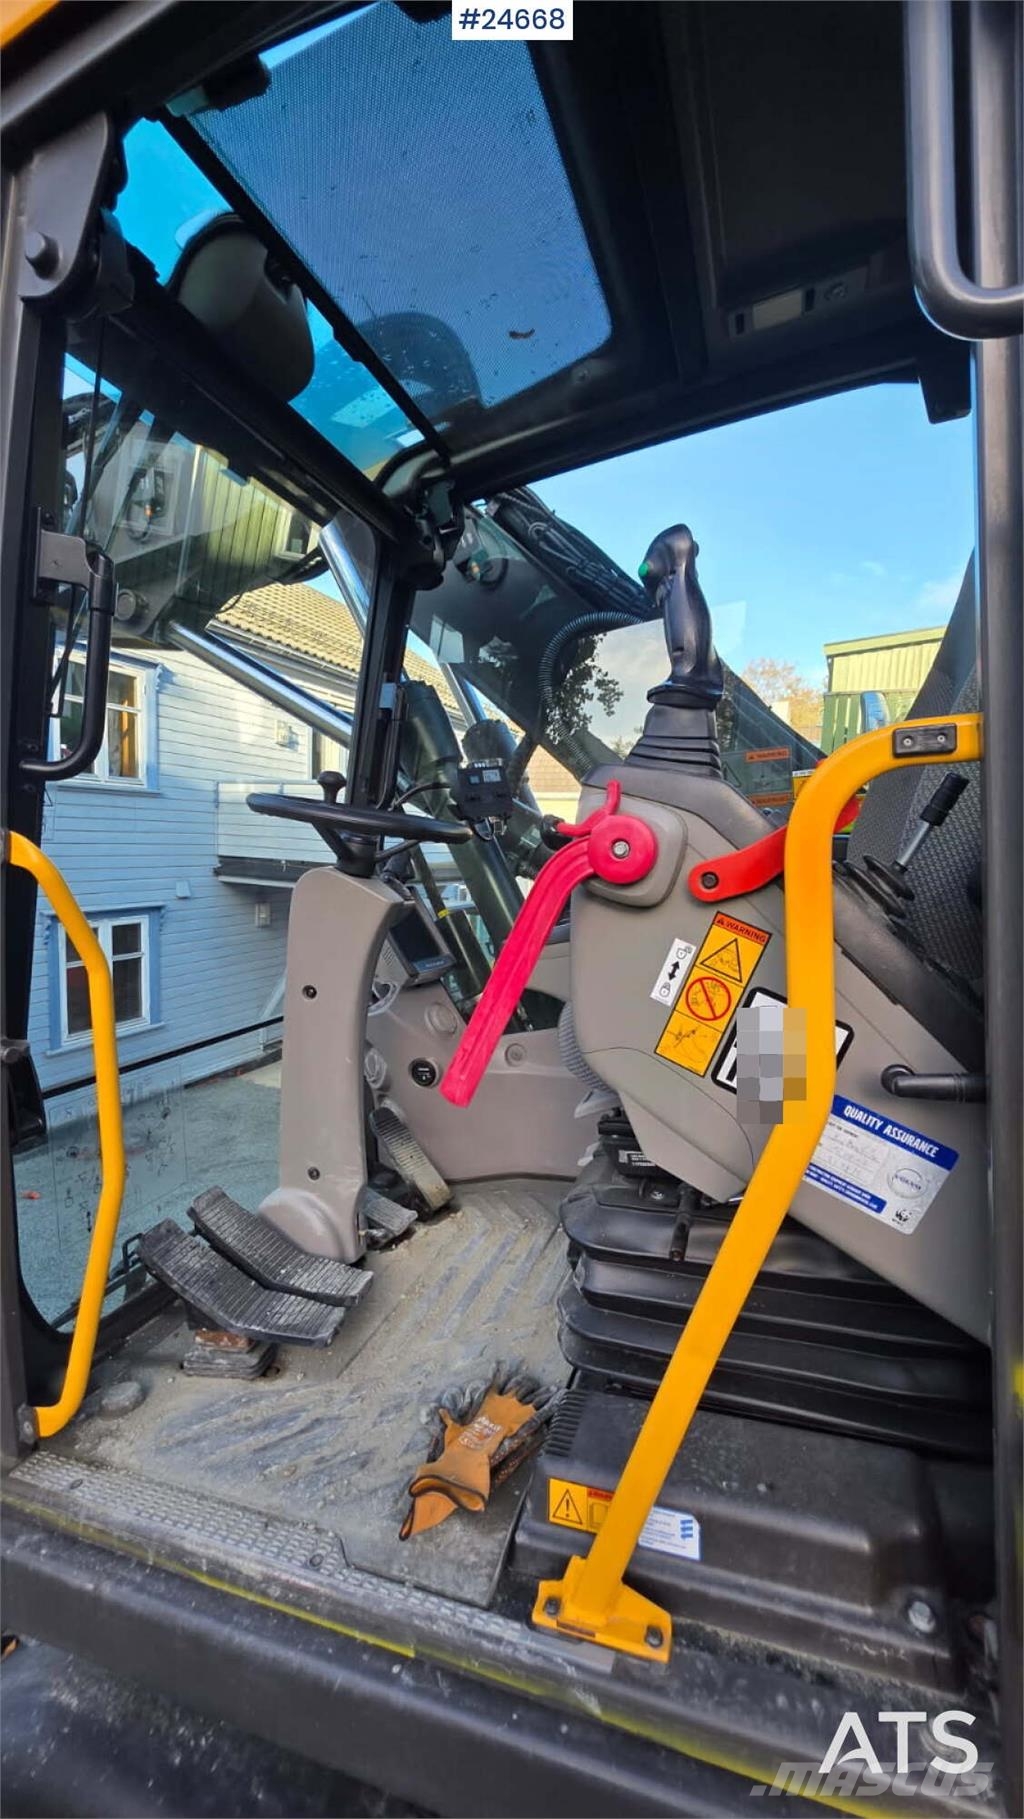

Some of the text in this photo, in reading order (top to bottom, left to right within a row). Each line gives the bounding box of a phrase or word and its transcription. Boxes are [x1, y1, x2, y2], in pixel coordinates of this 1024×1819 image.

[726, 921, 766, 943] WARNING
[843, 1104, 884, 1131] QUALITY
[883, 1124, 940, 1158] ASSURANCE
